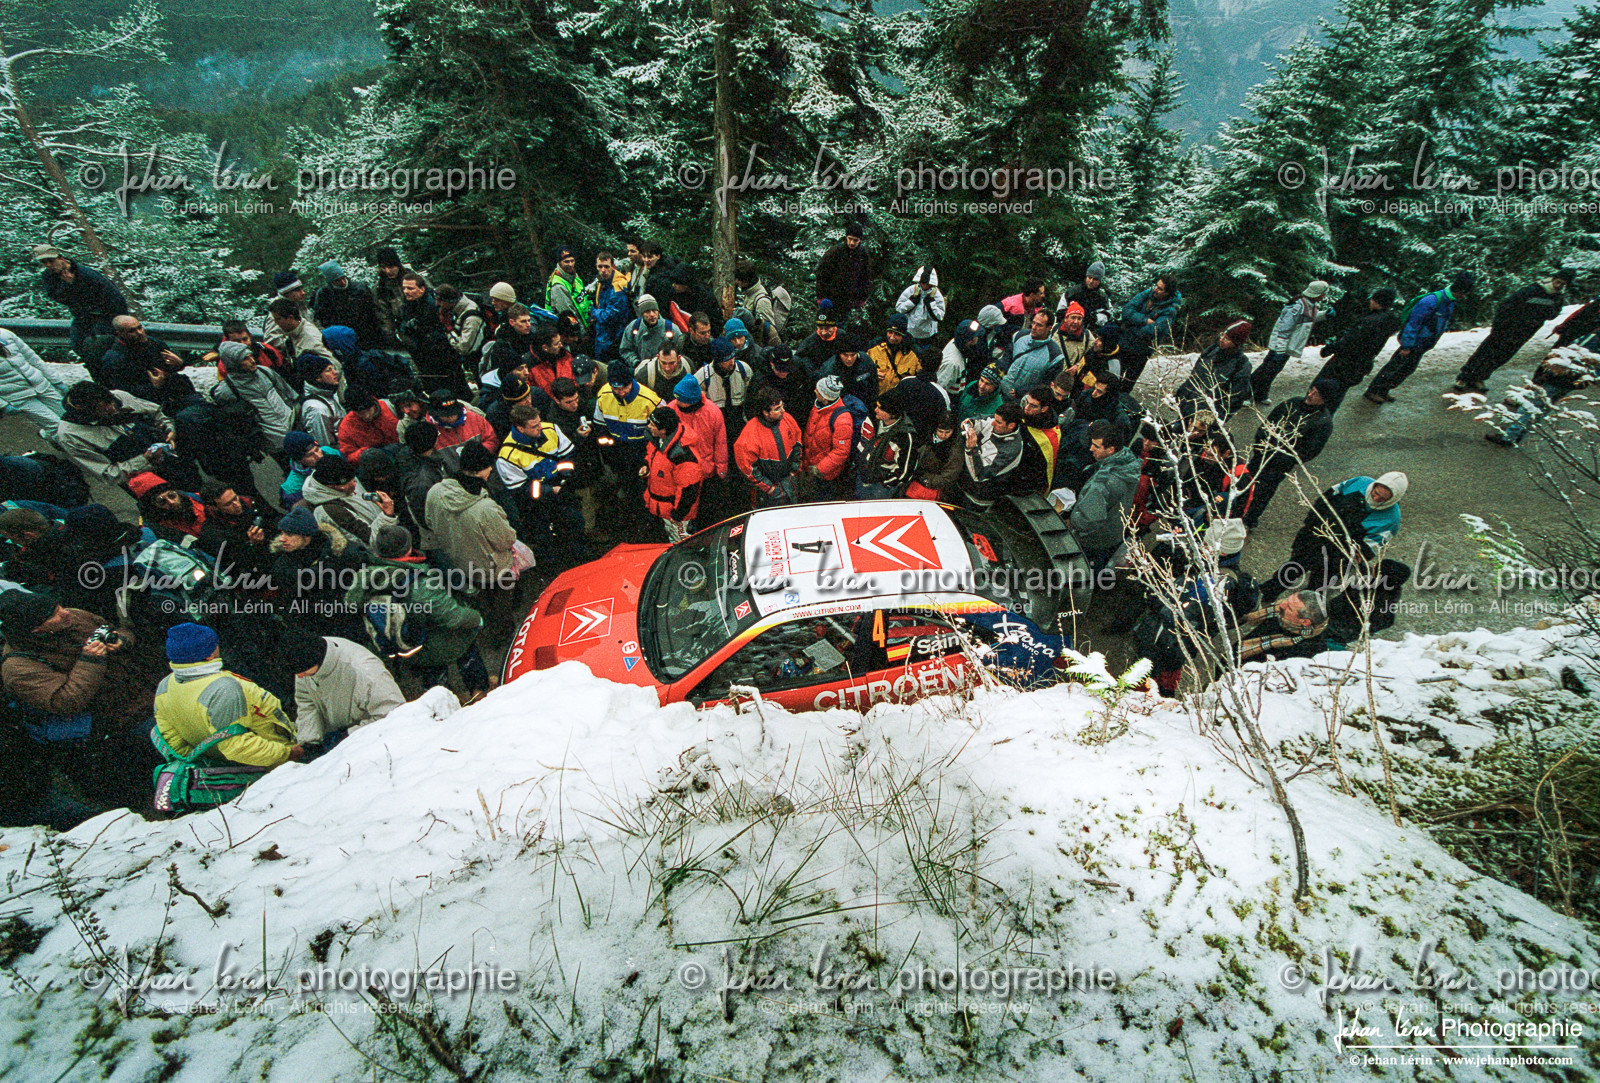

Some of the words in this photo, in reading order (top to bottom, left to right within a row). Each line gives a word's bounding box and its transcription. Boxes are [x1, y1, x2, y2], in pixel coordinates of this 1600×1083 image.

[792, 604, 862, 619] WWW.CITROEN.COM
[1058, 609, 1084, 619] TOTAL
[508, 607, 538, 678] TOTAL
[872, 609, 885, 648] 4
[917, 635, 960, 654] Sain
[813, 663, 966, 711] CITROËN
